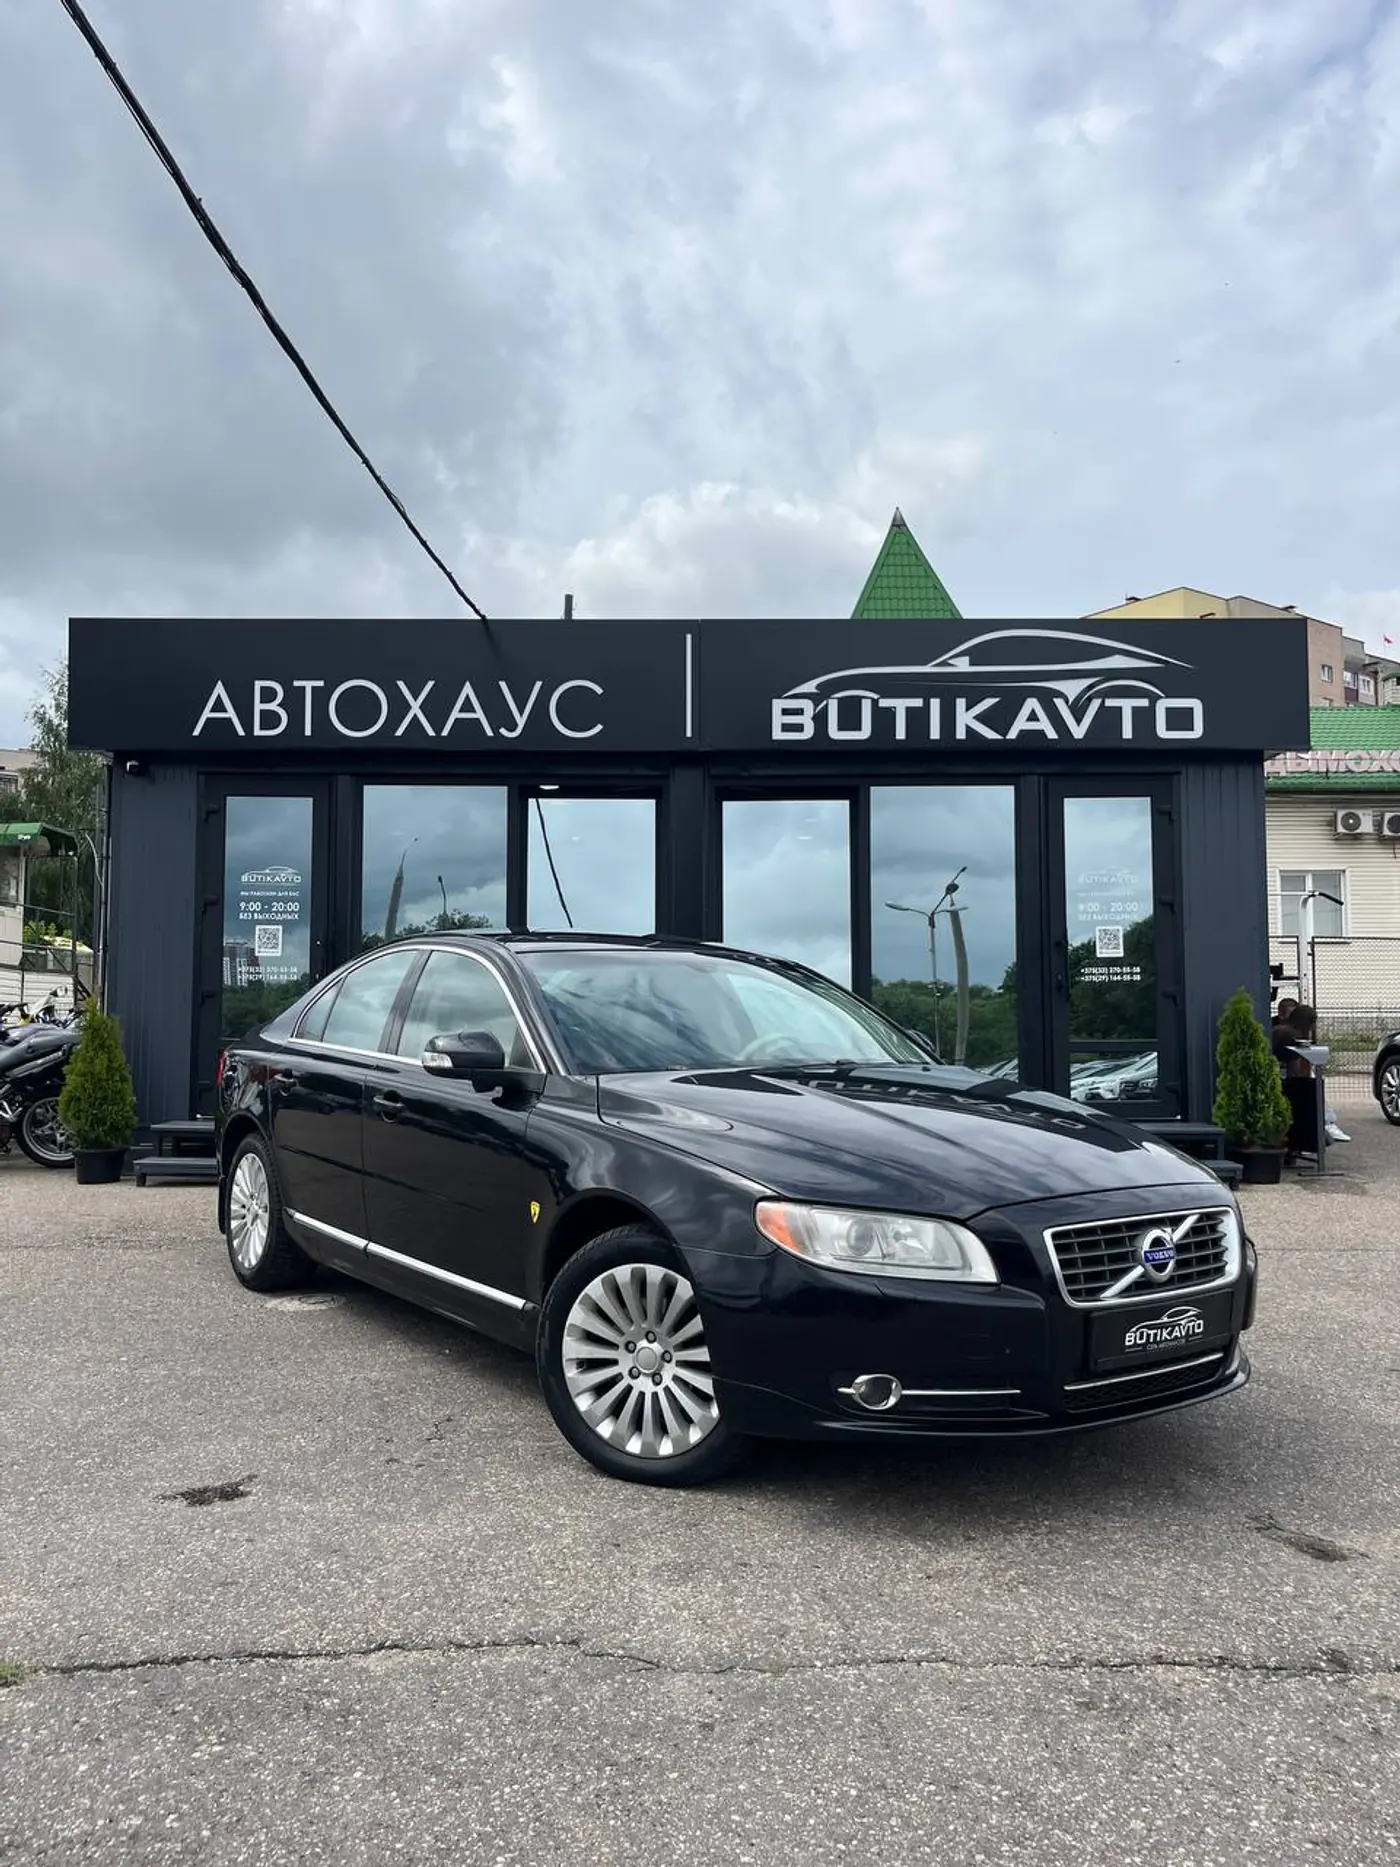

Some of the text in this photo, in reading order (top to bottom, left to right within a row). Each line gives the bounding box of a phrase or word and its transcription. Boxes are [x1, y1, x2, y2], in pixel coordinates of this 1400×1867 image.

[192, 679, 605, 739] АВТОХАУС
[771, 696, 1204, 741] BUTIKAVTO
[241, 874, 301, 883] BUTIKAVTO
[239, 901, 262, 912] 9:00
[271, 901, 300, 912] 20:00
[1110, 902, 1139, 912] 20:00
[1146, 1249, 1175, 1260] VOLVO
[1125, 1320, 1204, 1346] BUTIKAVTO
